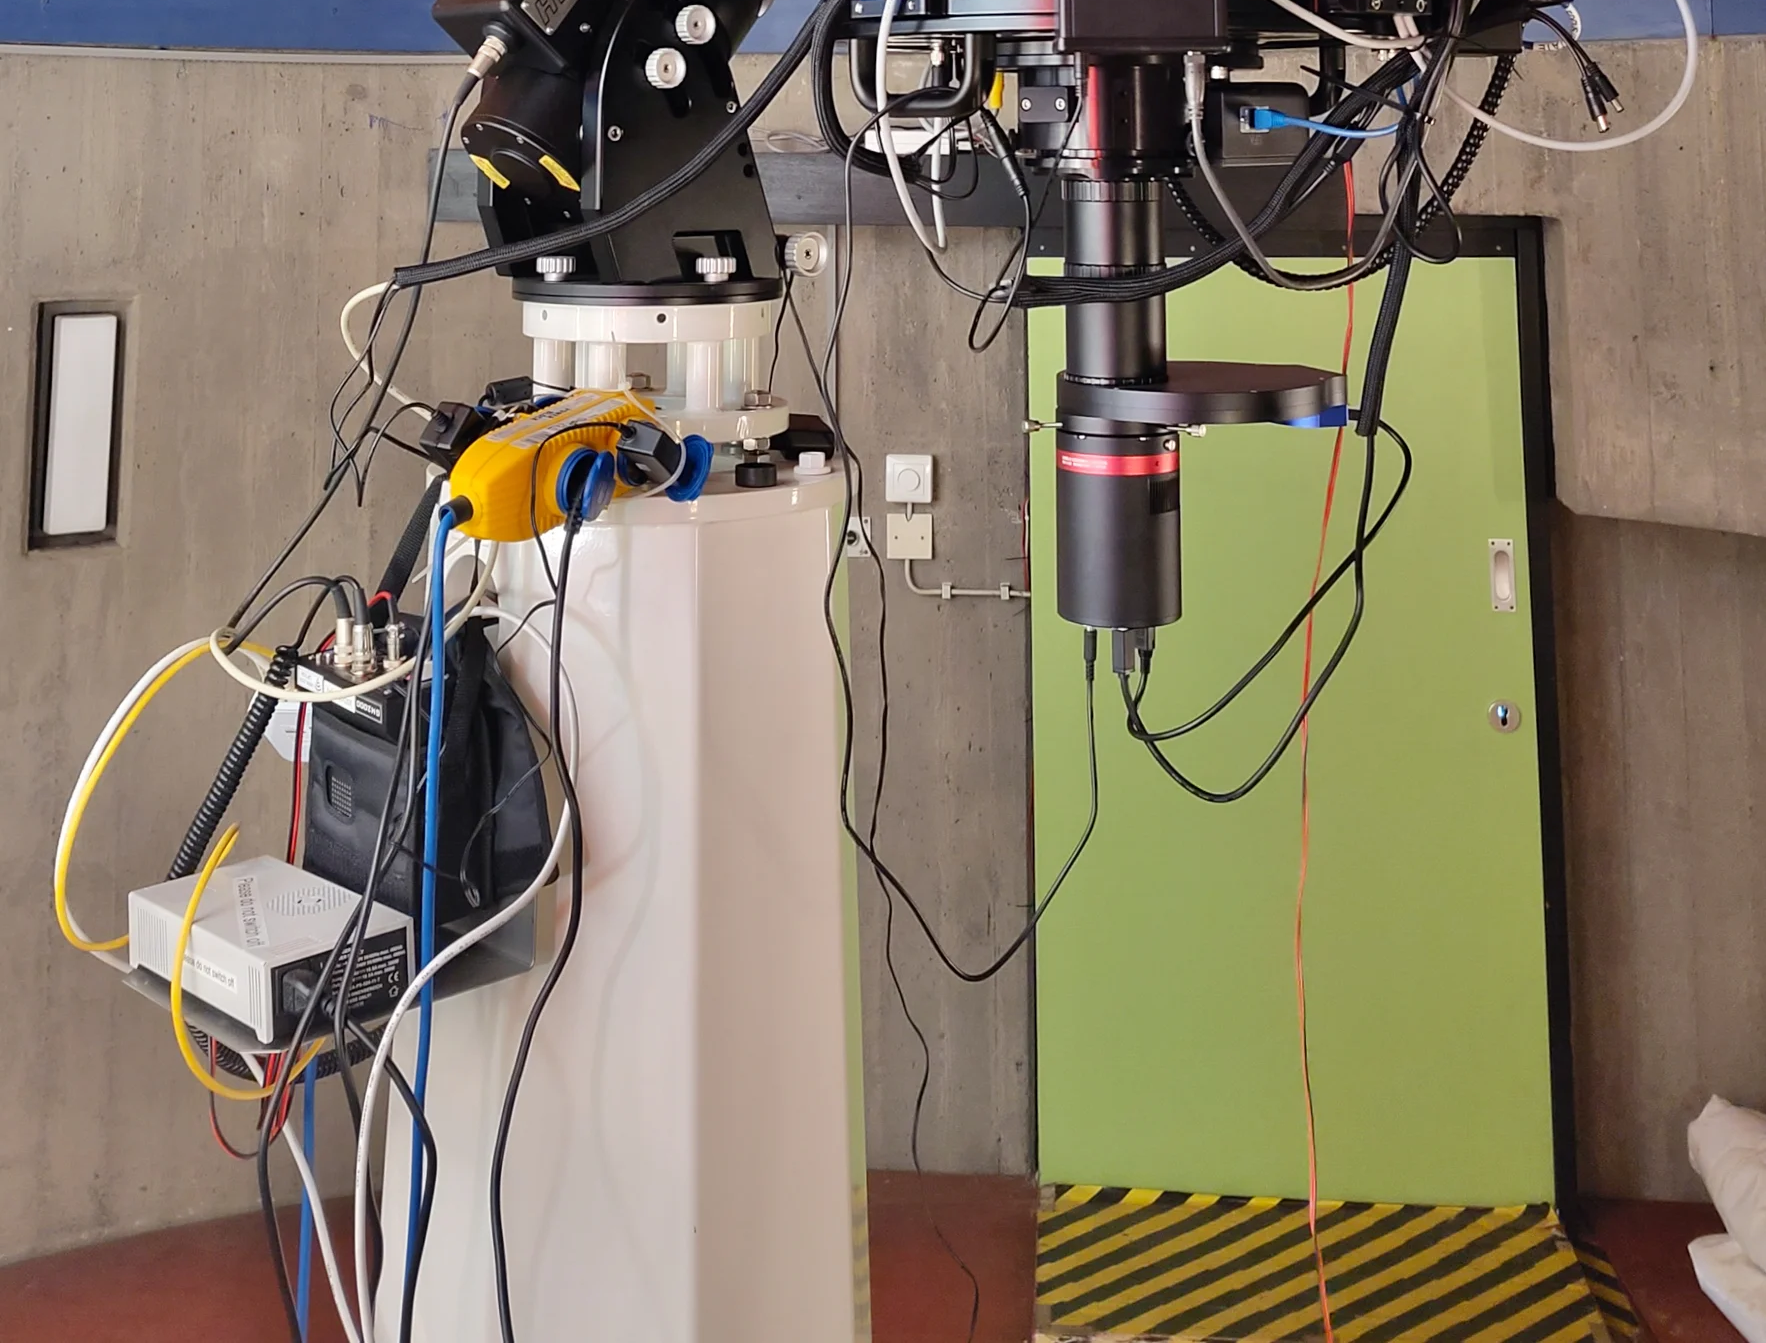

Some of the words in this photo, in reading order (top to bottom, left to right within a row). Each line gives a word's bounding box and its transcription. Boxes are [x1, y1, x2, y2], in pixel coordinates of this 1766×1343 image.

[237, 877, 254, 898] Please
[240, 898, 256, 907] do
[241, 907, 258, 918] not
[243, 917, 262, 938] switch
[246, 938, 265, 948] off
[196, 959, 203, 971] do
[203, 964, 212, 977] not
[227, 976, 235, 988] off
